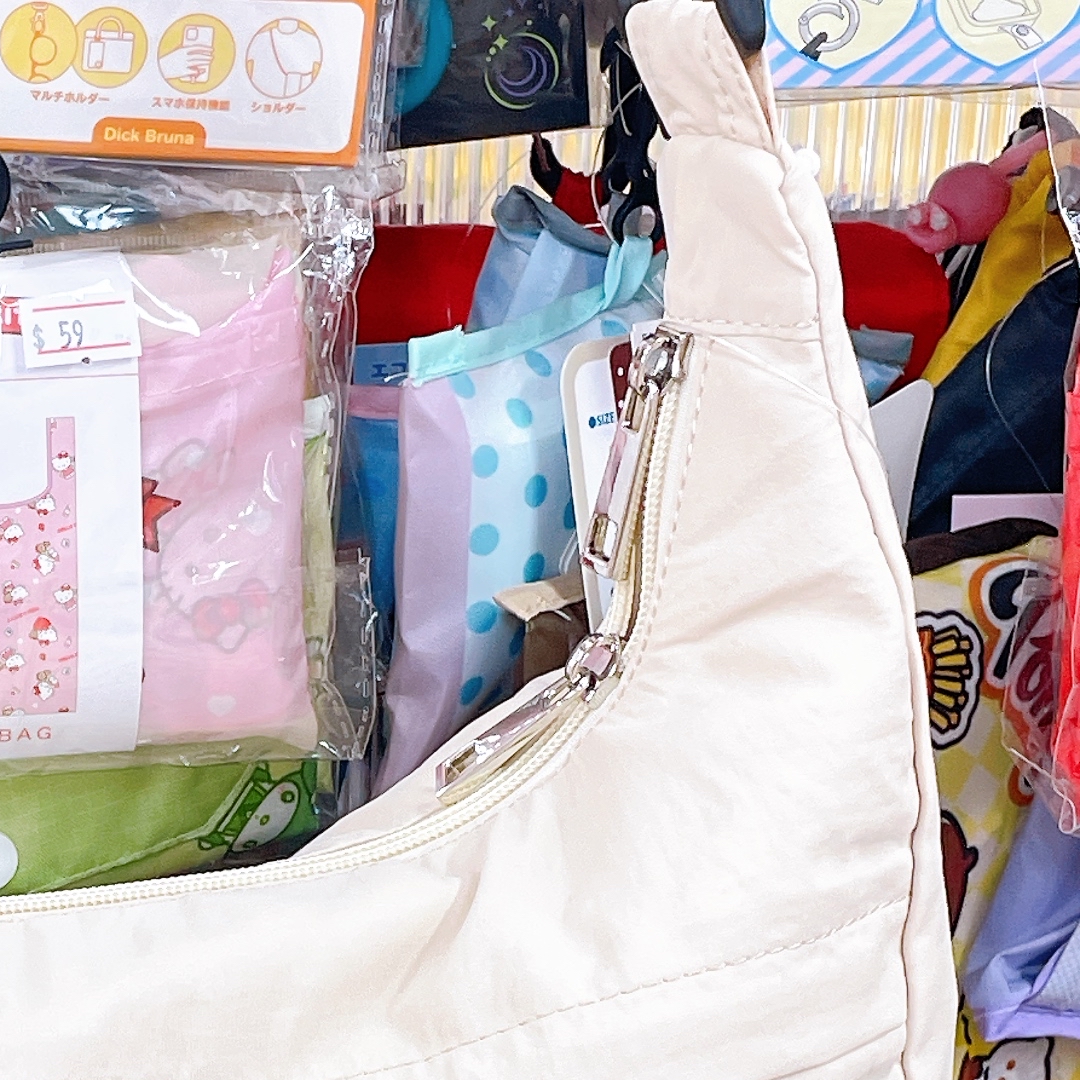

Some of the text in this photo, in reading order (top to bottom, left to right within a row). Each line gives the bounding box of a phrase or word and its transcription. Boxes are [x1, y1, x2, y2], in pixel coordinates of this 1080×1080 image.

[30, 89, 110, 105] マルチホルダー
[250, 101, 307, 114] ショルダー
[103, 126, 195, 146] Dick Bruna
[58, 319, 84, 350] 59
